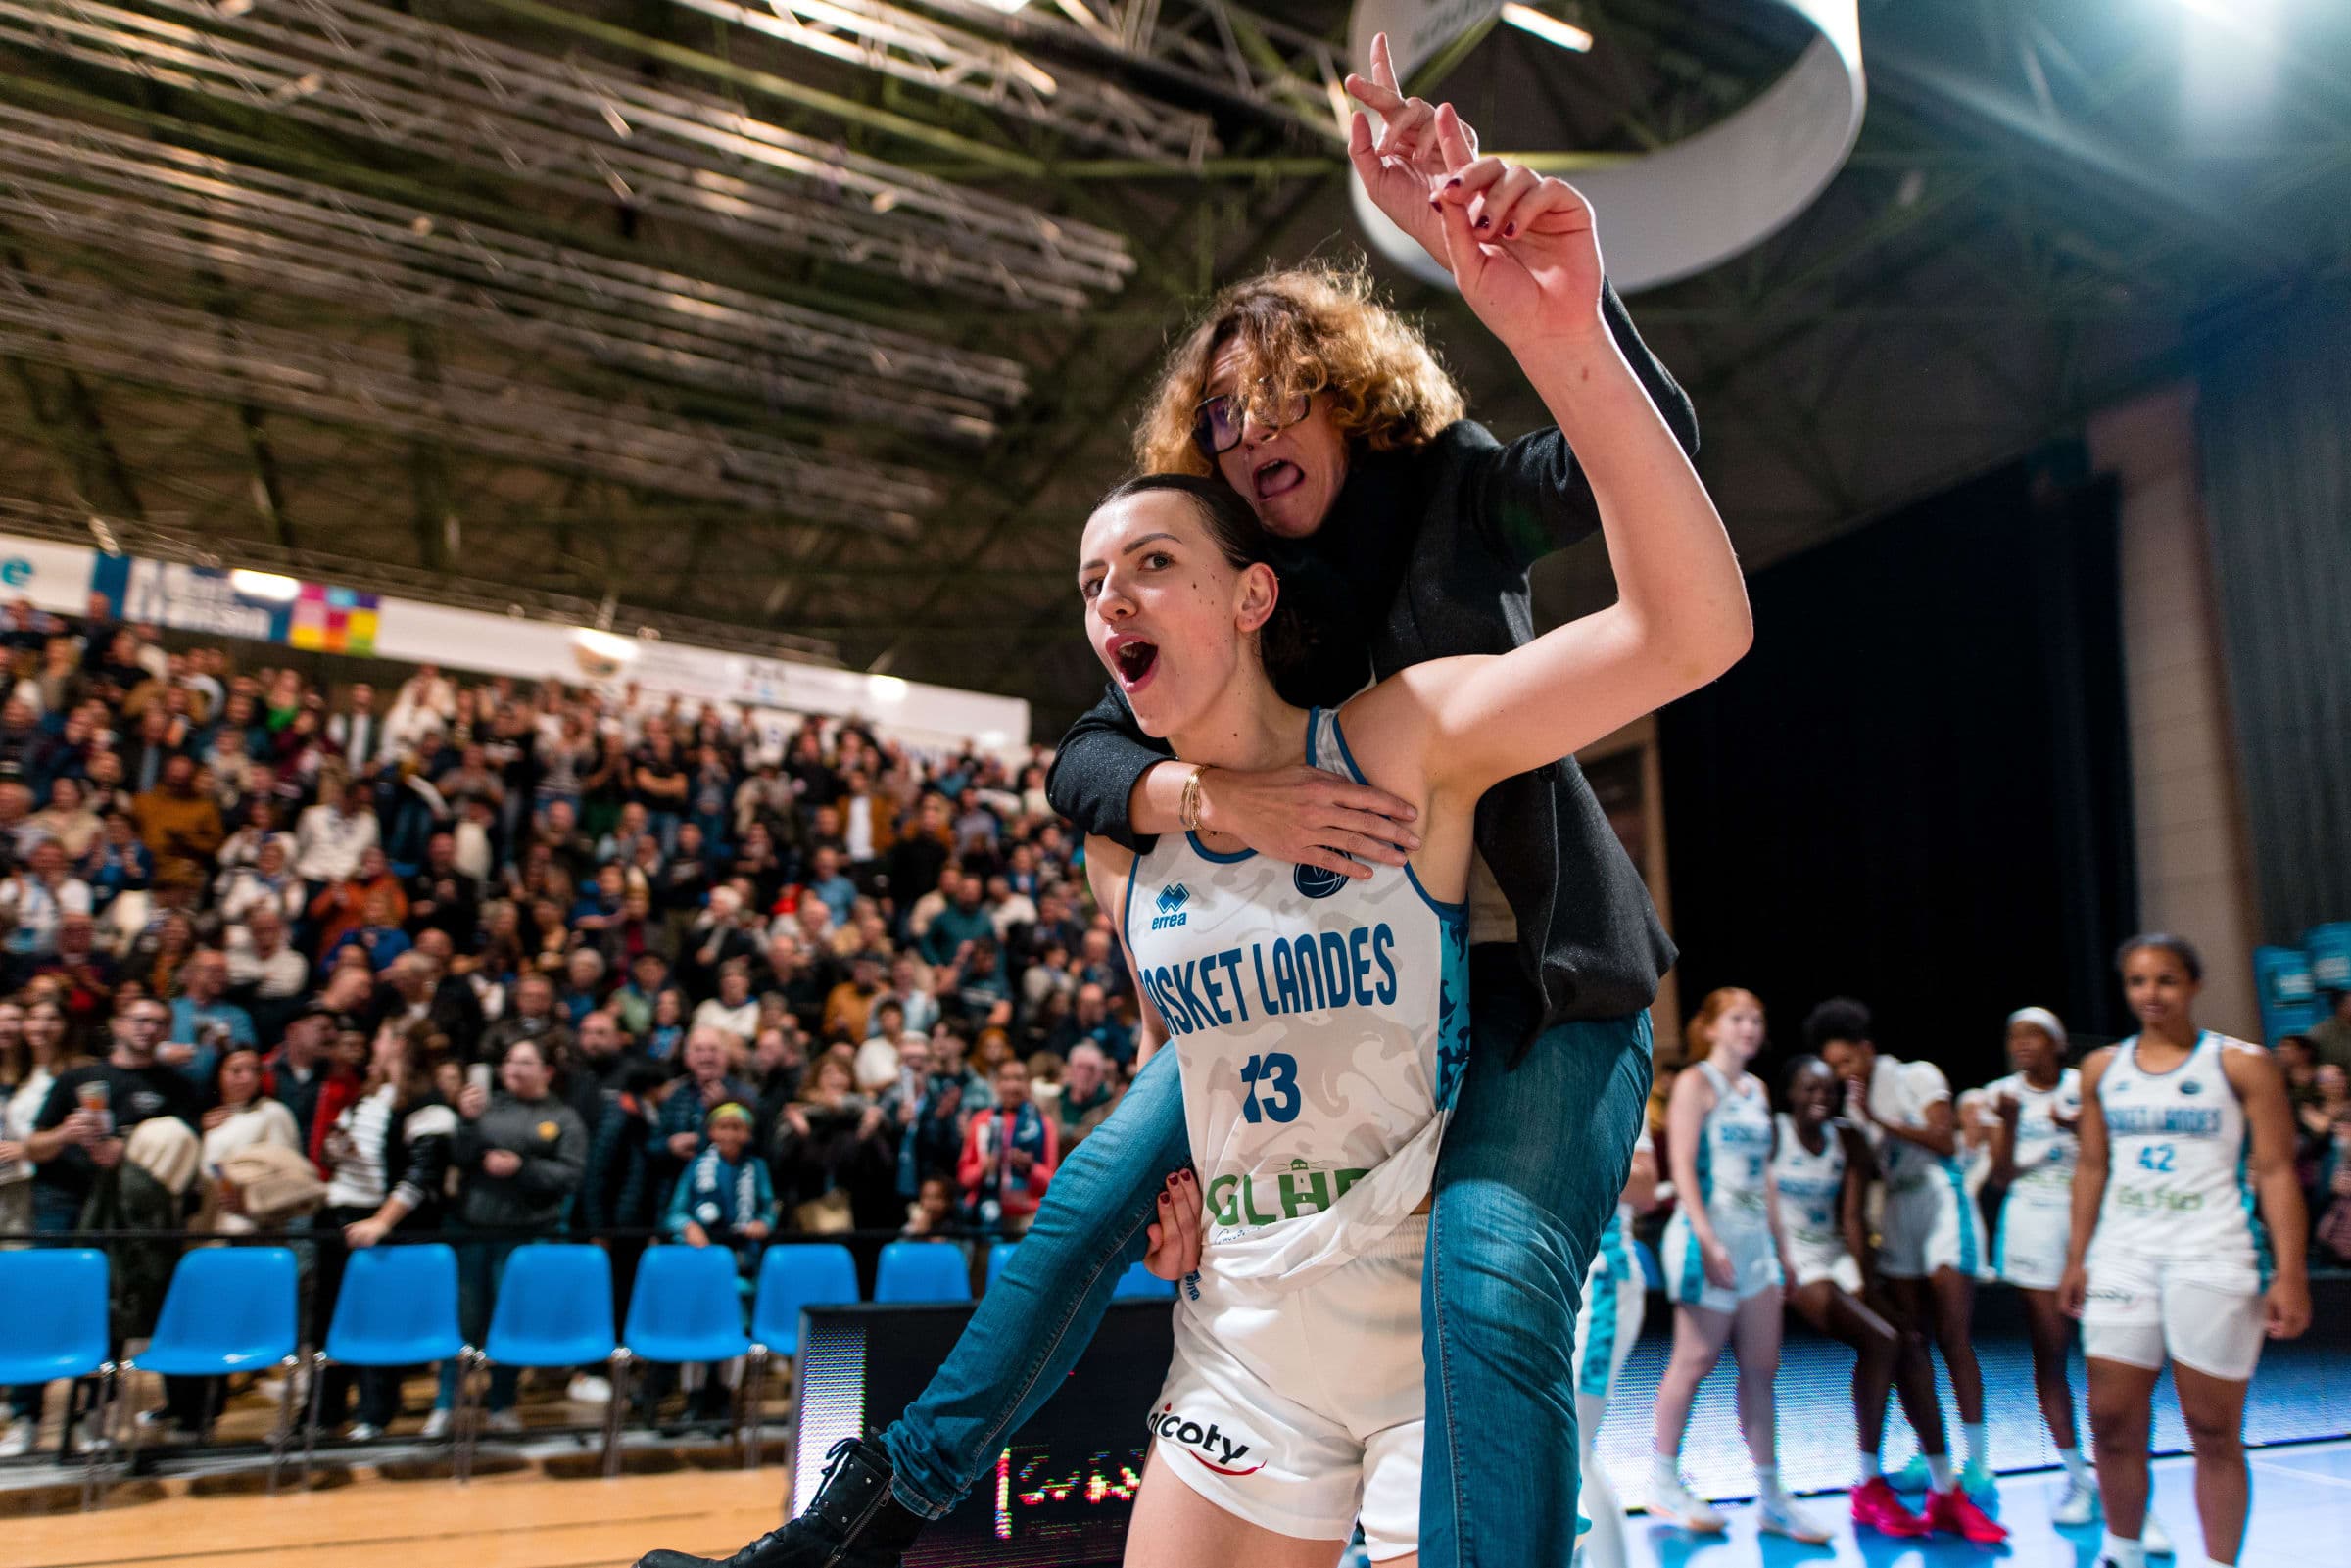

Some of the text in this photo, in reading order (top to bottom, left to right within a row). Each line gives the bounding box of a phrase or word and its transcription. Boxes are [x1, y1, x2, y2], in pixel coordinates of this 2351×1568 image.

[1151, 912, 1187, 930] errea
[1138, 923, 1398, 1035] ASKET LANDES
[1240, 1052, 1302, 1124] 13
[2139, 1143, 2176, 1171] 42
